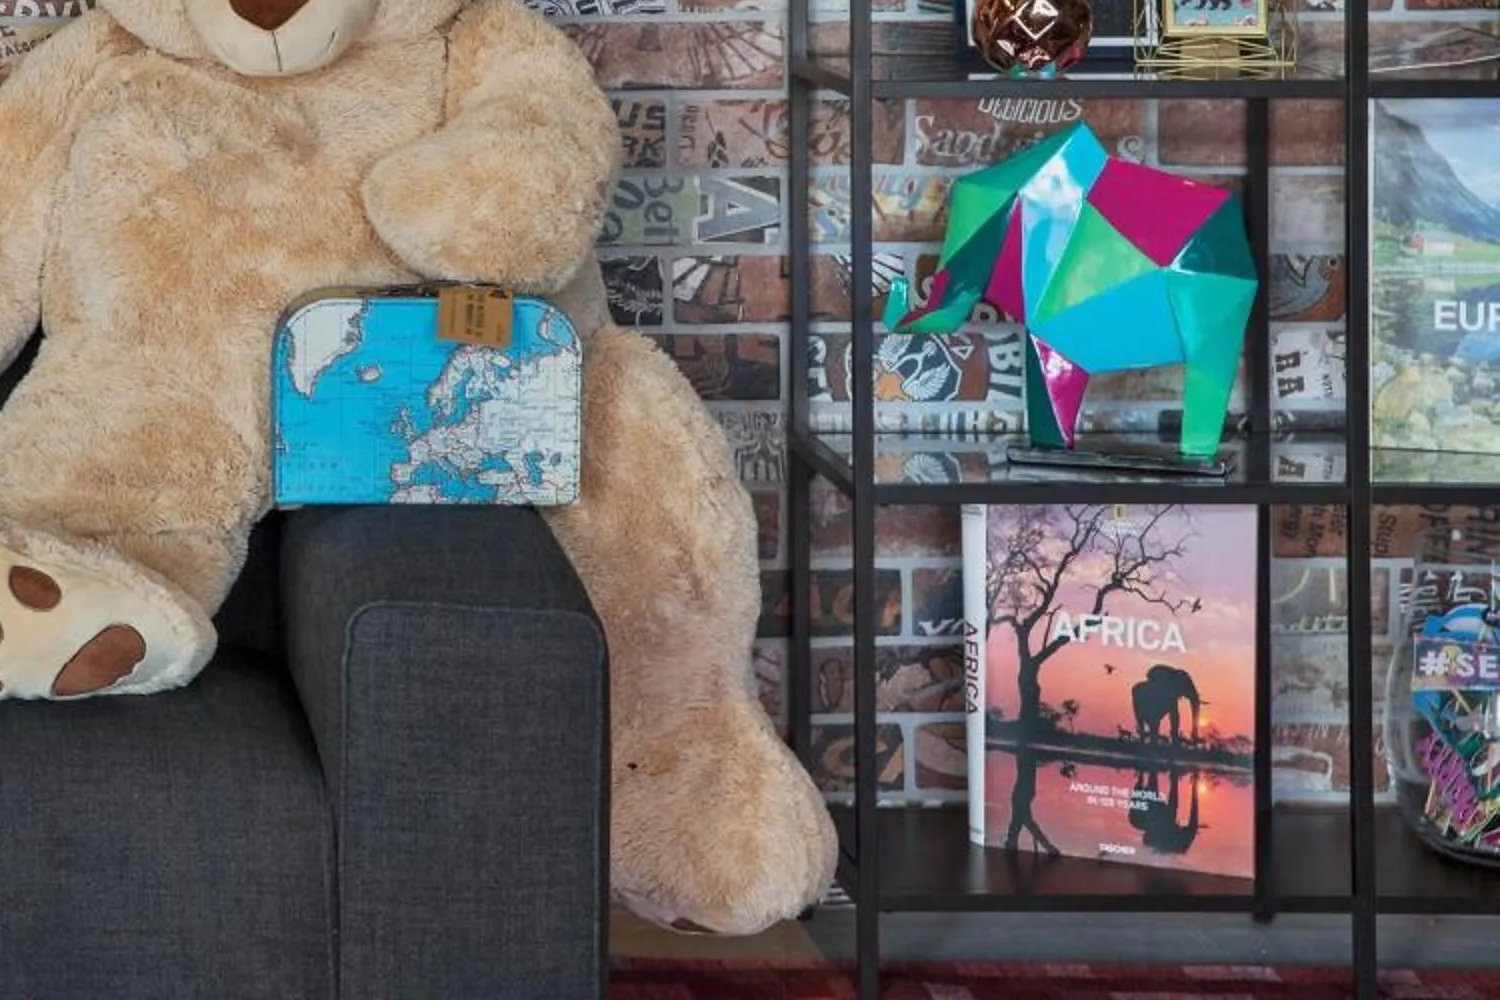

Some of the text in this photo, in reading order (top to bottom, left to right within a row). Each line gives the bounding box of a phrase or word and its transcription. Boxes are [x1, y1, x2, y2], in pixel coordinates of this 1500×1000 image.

[1050, 611, 1188, 654] AFRICA
[963, 619, 980, 717] AFRICA
[1111, 786, 1130, 799] THE
